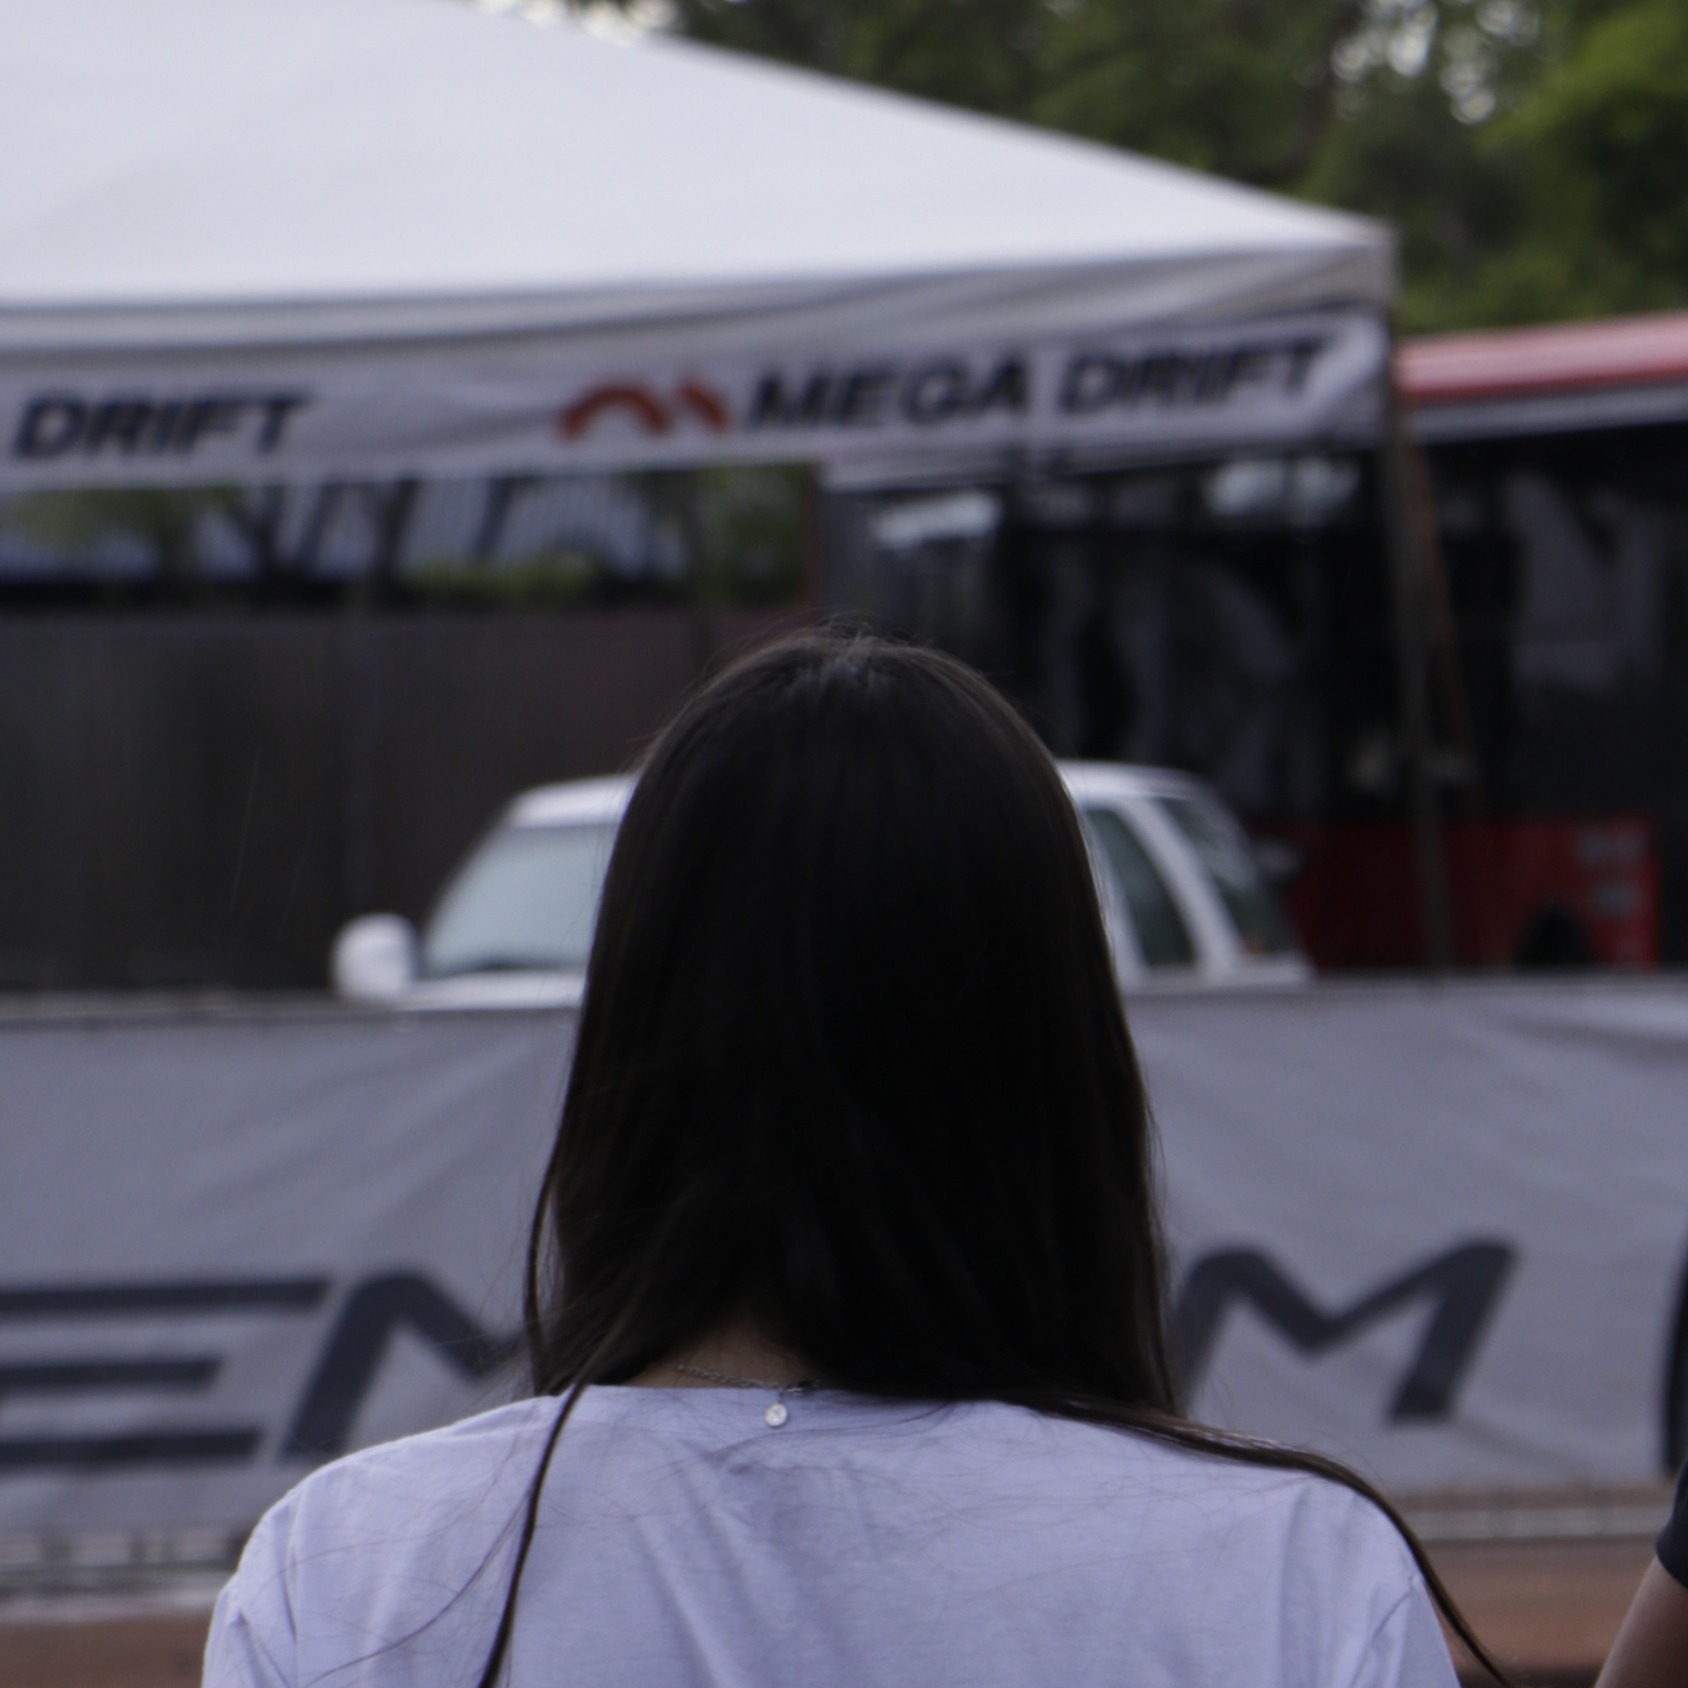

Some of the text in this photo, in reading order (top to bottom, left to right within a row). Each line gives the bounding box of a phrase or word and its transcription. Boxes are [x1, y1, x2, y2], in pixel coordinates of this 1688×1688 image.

[750, 338, 1331, 428] MEGA DRIFT
[13, 392, 309, 457] DRIFT
